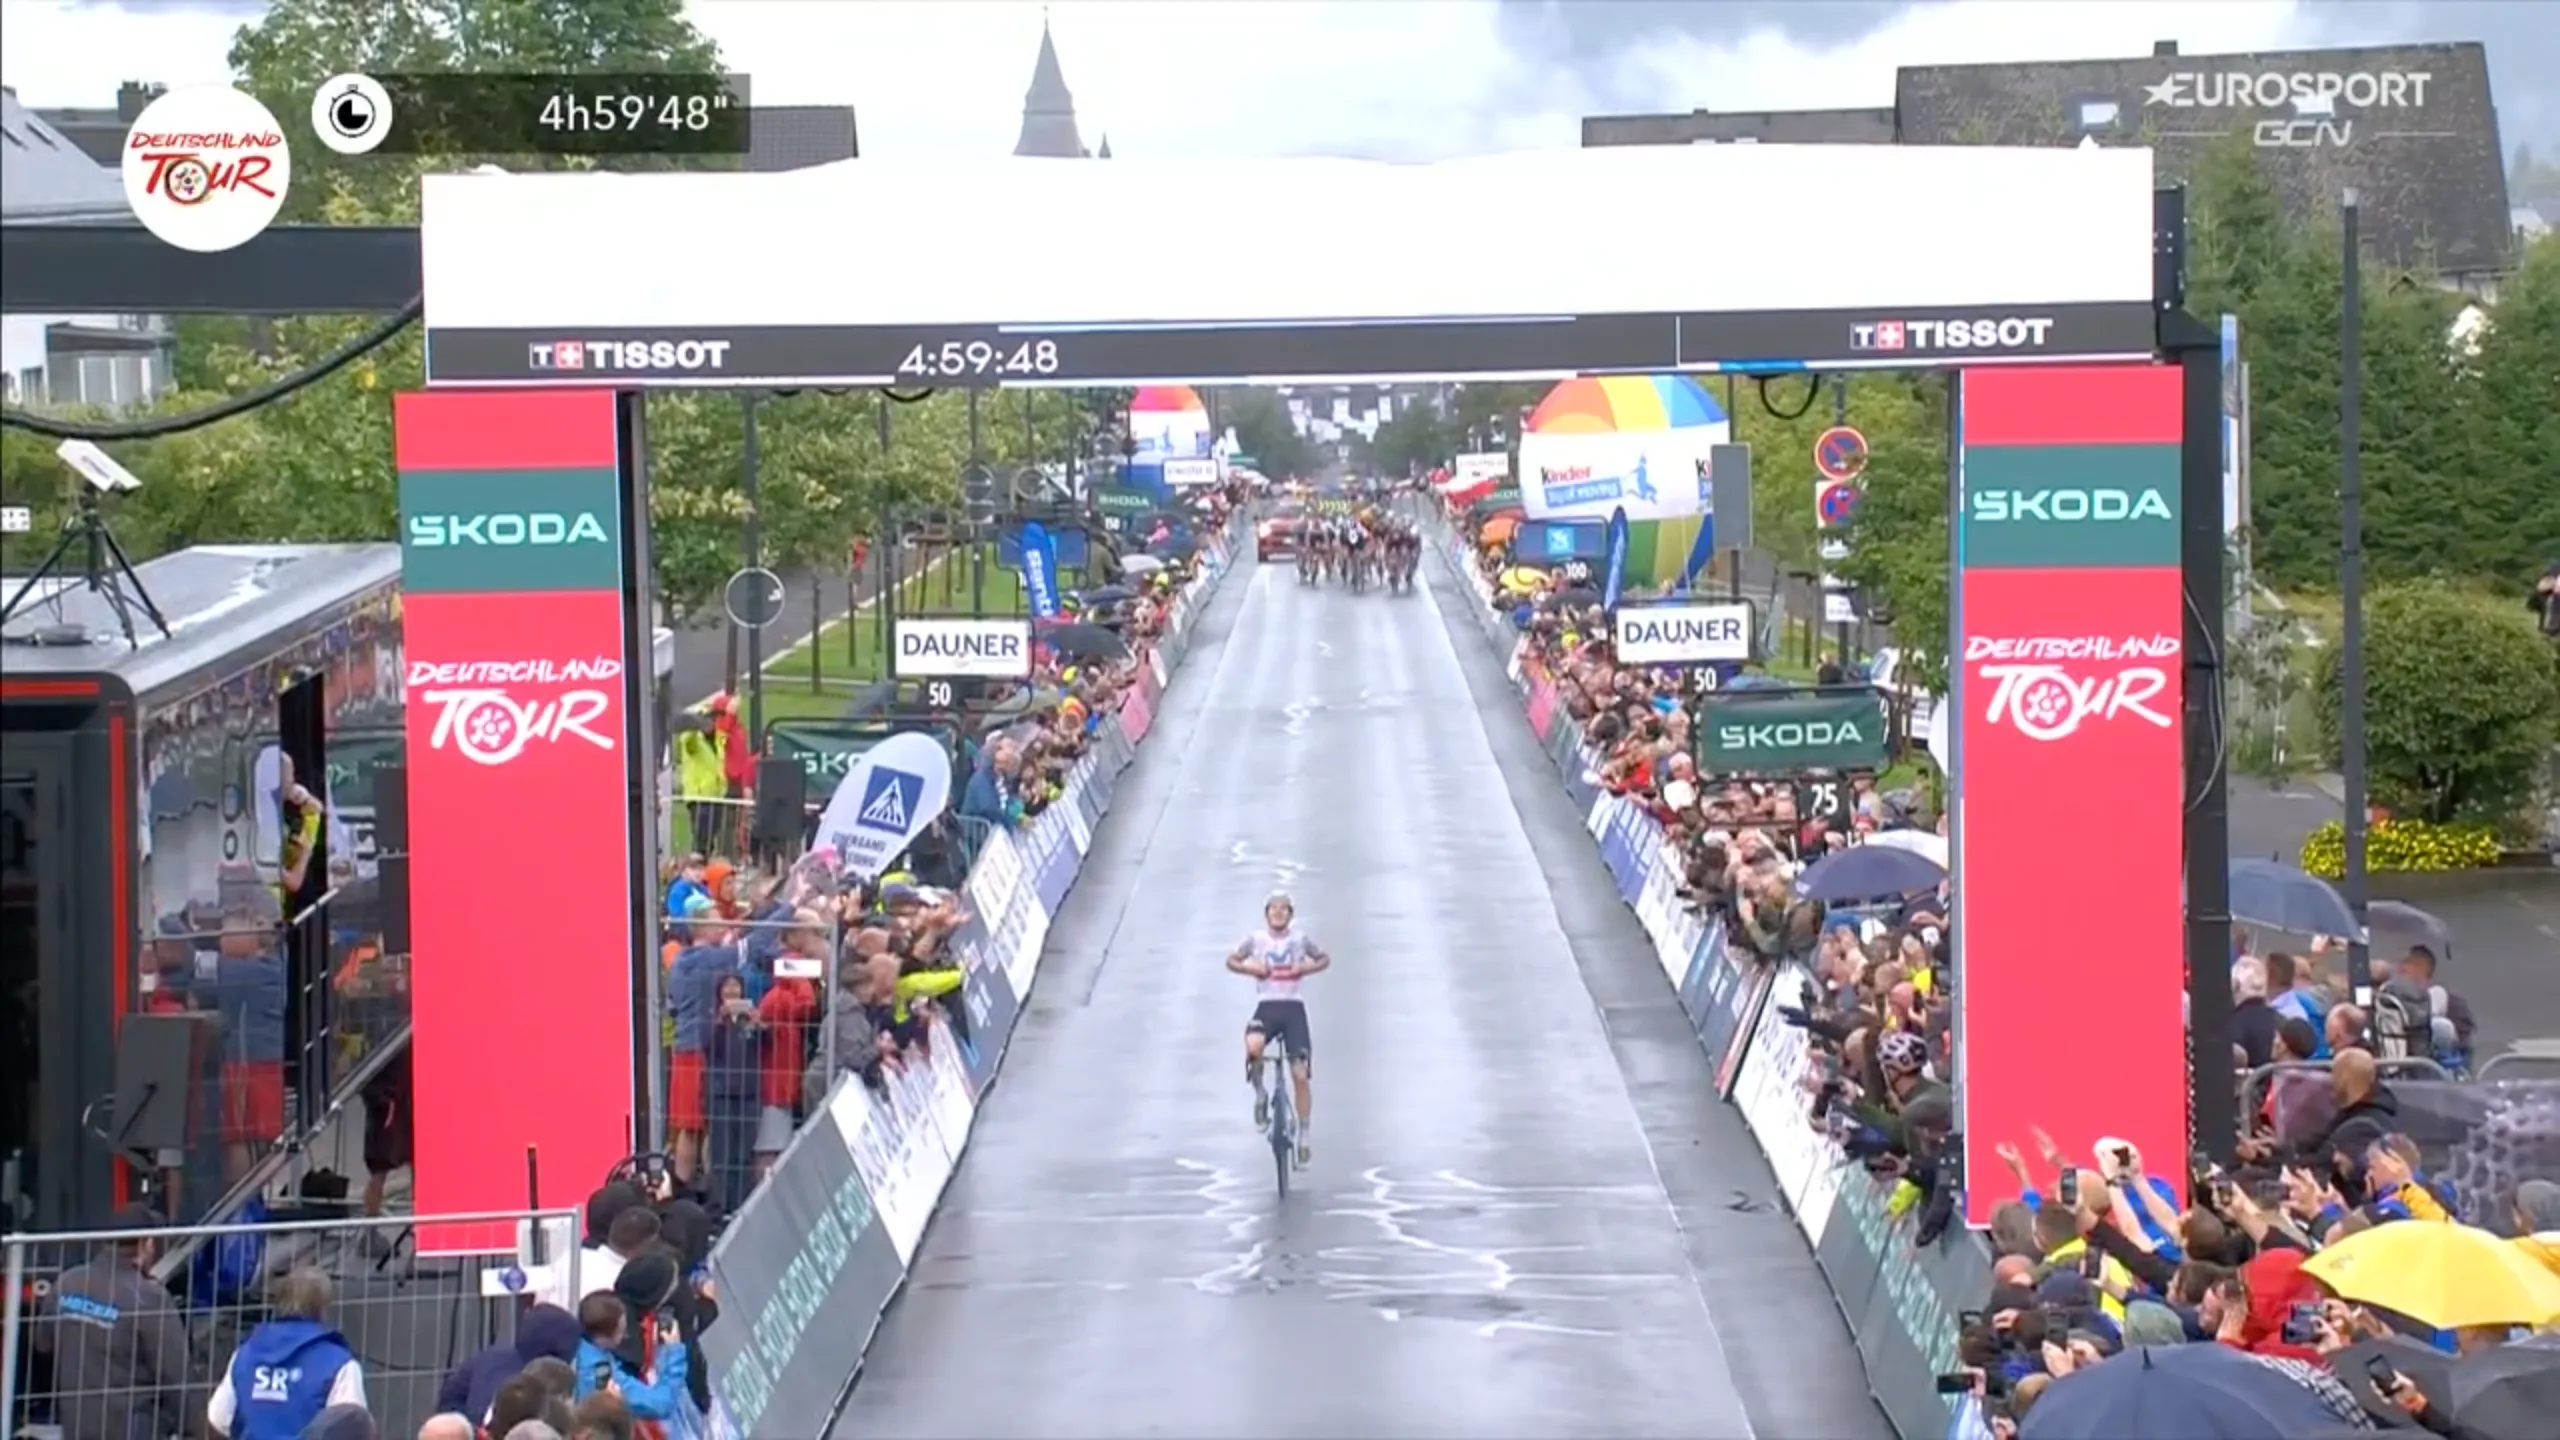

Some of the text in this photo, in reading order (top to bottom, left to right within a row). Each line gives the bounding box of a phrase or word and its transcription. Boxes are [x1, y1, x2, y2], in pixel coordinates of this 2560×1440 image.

[1906, 318, 2054, 348] TISSOT
[585, 340, 730, 369] TISSOT
[898, 339, 1059, 376] 4:59:48
[1973, 488, 2172, 521] SKODA
[409, 512, 608, 546] SKODA
[1625, 617, 1741, 643] DAUNER
[903, 633, 1020, 657] DAUNER
[1965, 632, 2181, 661] DEUTSCHLAND
[408, 654, 622, 686] DEUTSCHLAND
[1694, 667, 1718, 691] 50
[929, 682, 952, 706] 50
[1979, 664, 2173, 741] TOUR
[423, 688, 615, 765] TOUR
[1720, 720, 1863, 749] SKODA
[255, 1365, 289, 1390] SR
